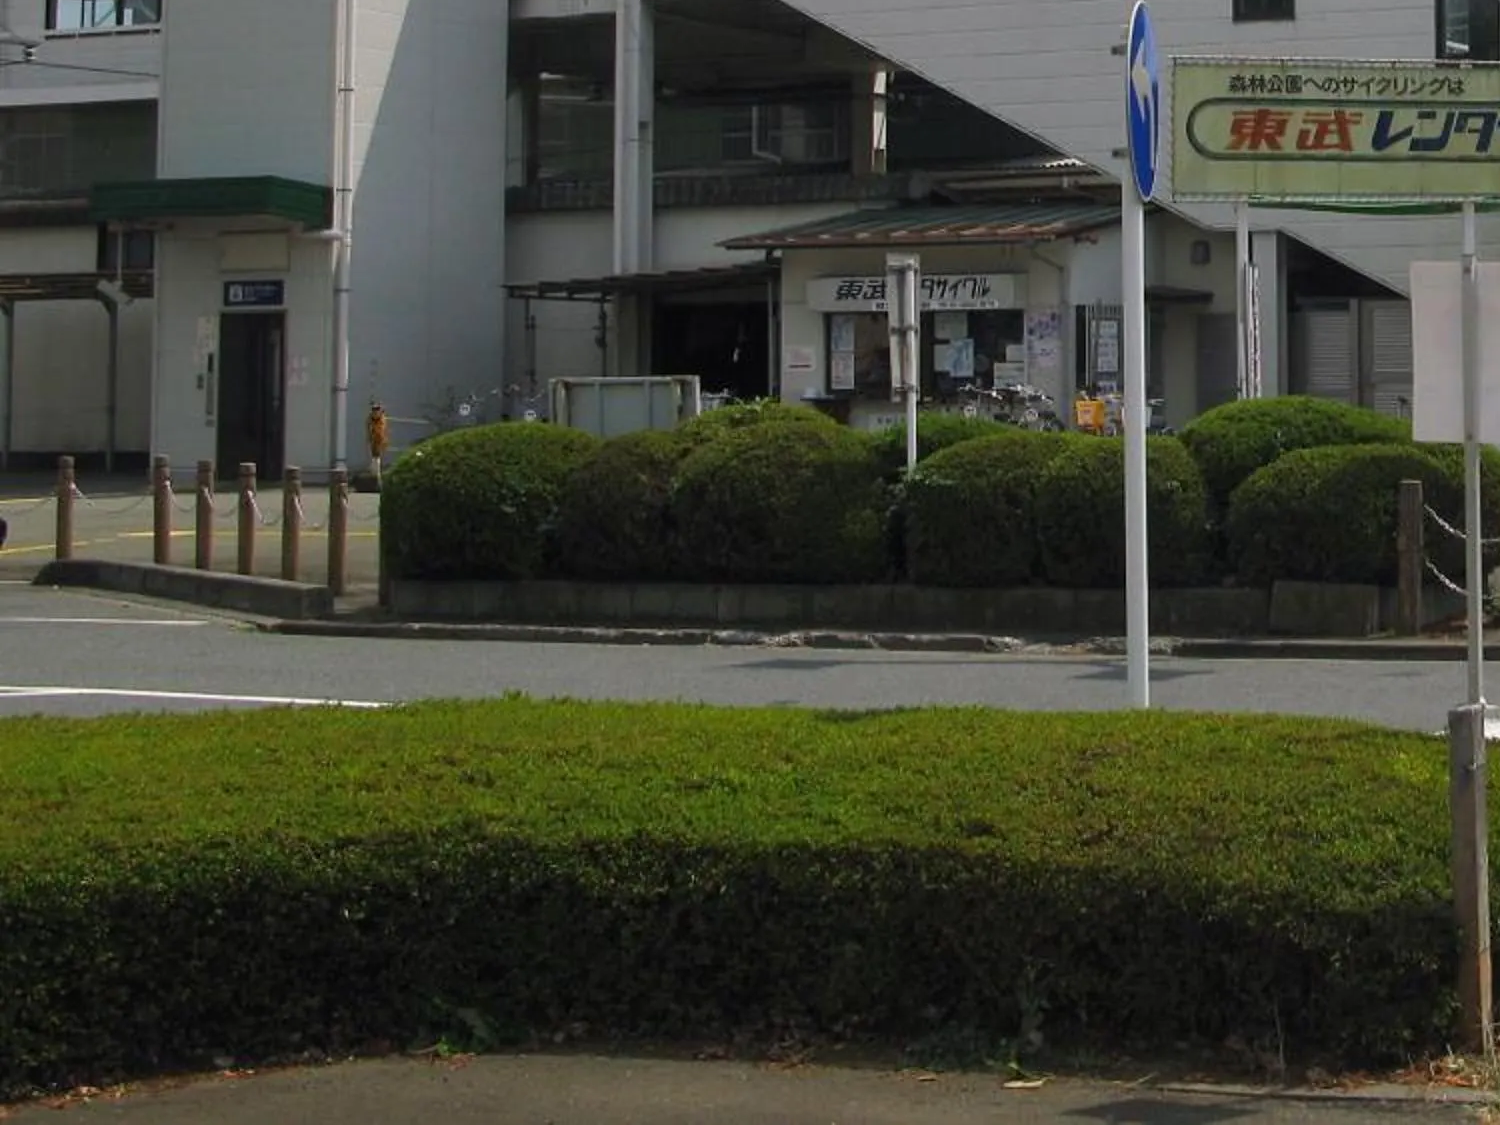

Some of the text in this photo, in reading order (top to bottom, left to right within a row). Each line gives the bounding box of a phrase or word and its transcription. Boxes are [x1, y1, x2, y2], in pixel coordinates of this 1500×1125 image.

[1228, 74, 1466, 96] 森林公園へのサイクリングは
